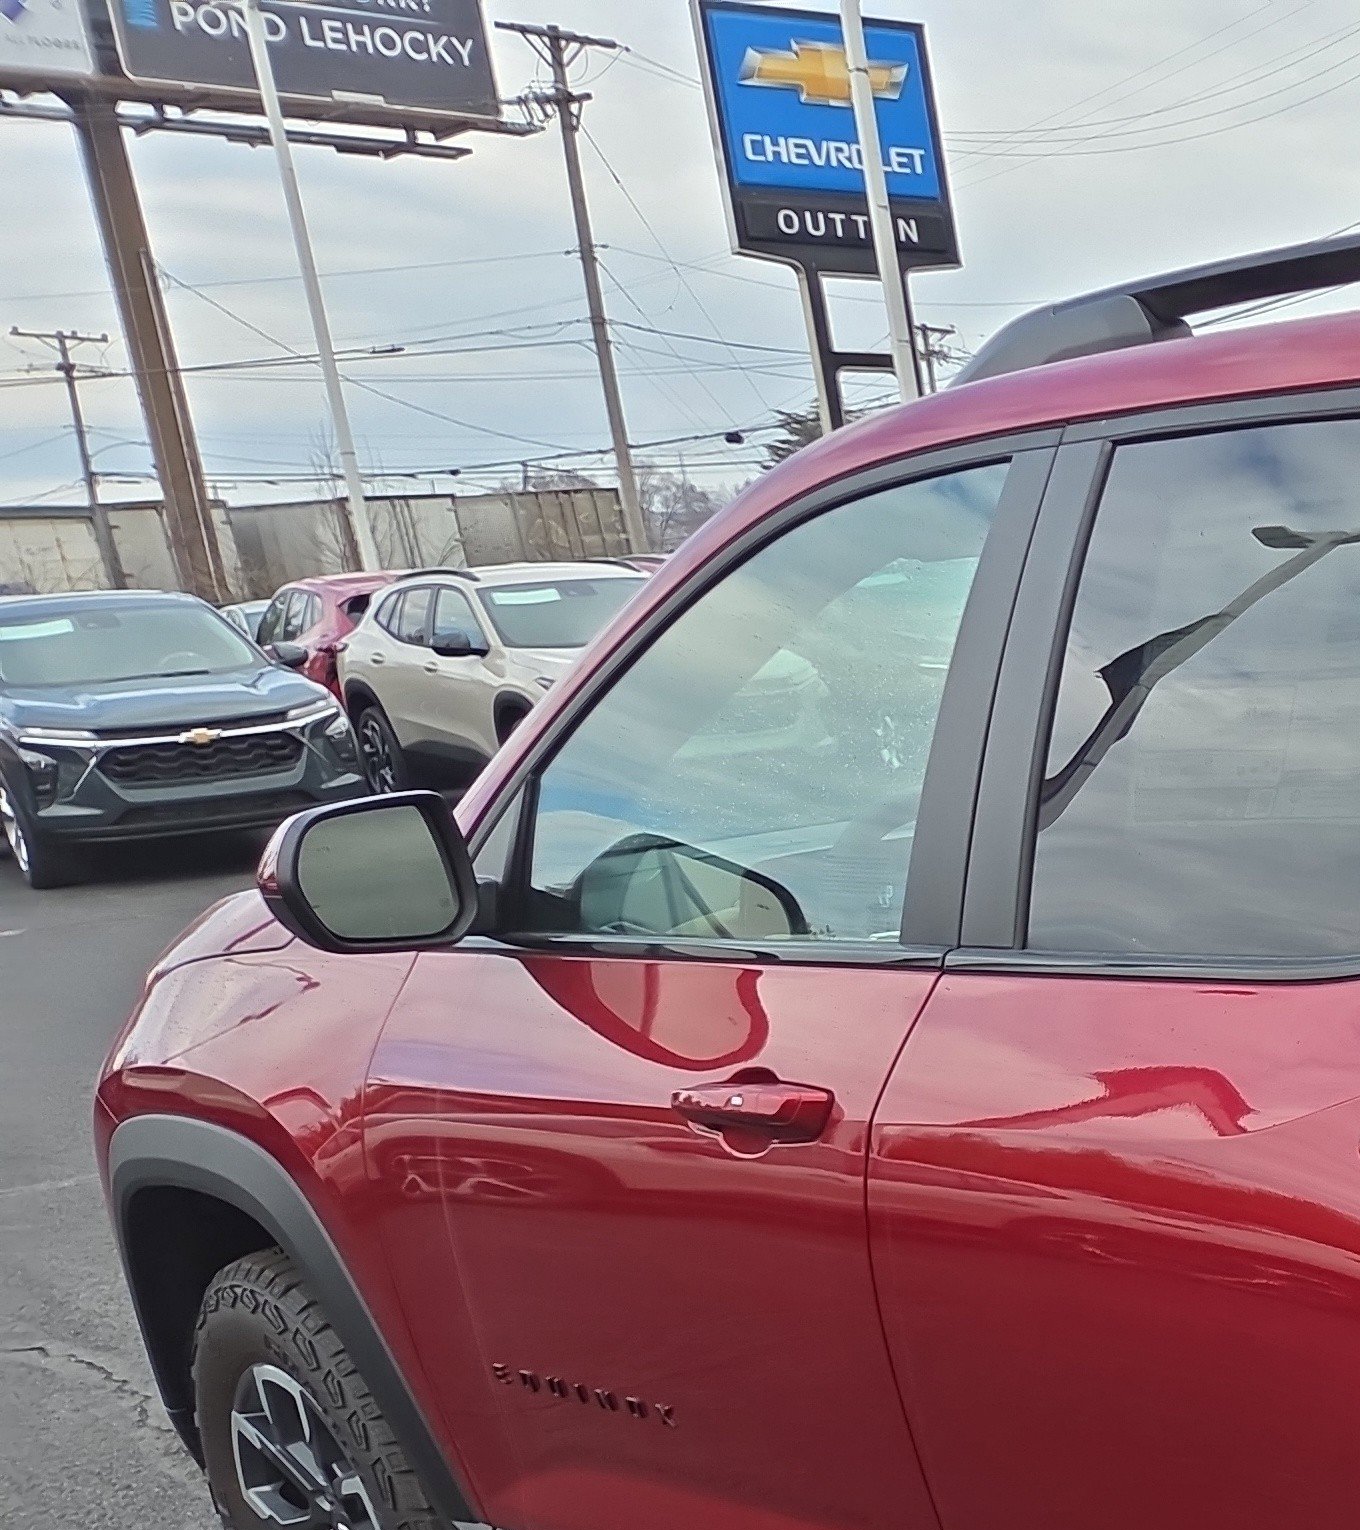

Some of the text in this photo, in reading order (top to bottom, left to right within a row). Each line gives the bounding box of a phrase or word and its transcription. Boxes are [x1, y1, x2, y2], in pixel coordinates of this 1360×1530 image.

[170, 0, 474, 67] POND LEHOCKY
[742, 132, 926, 175] CHEVROET
[777, 208, 919, 243] OUTTN
